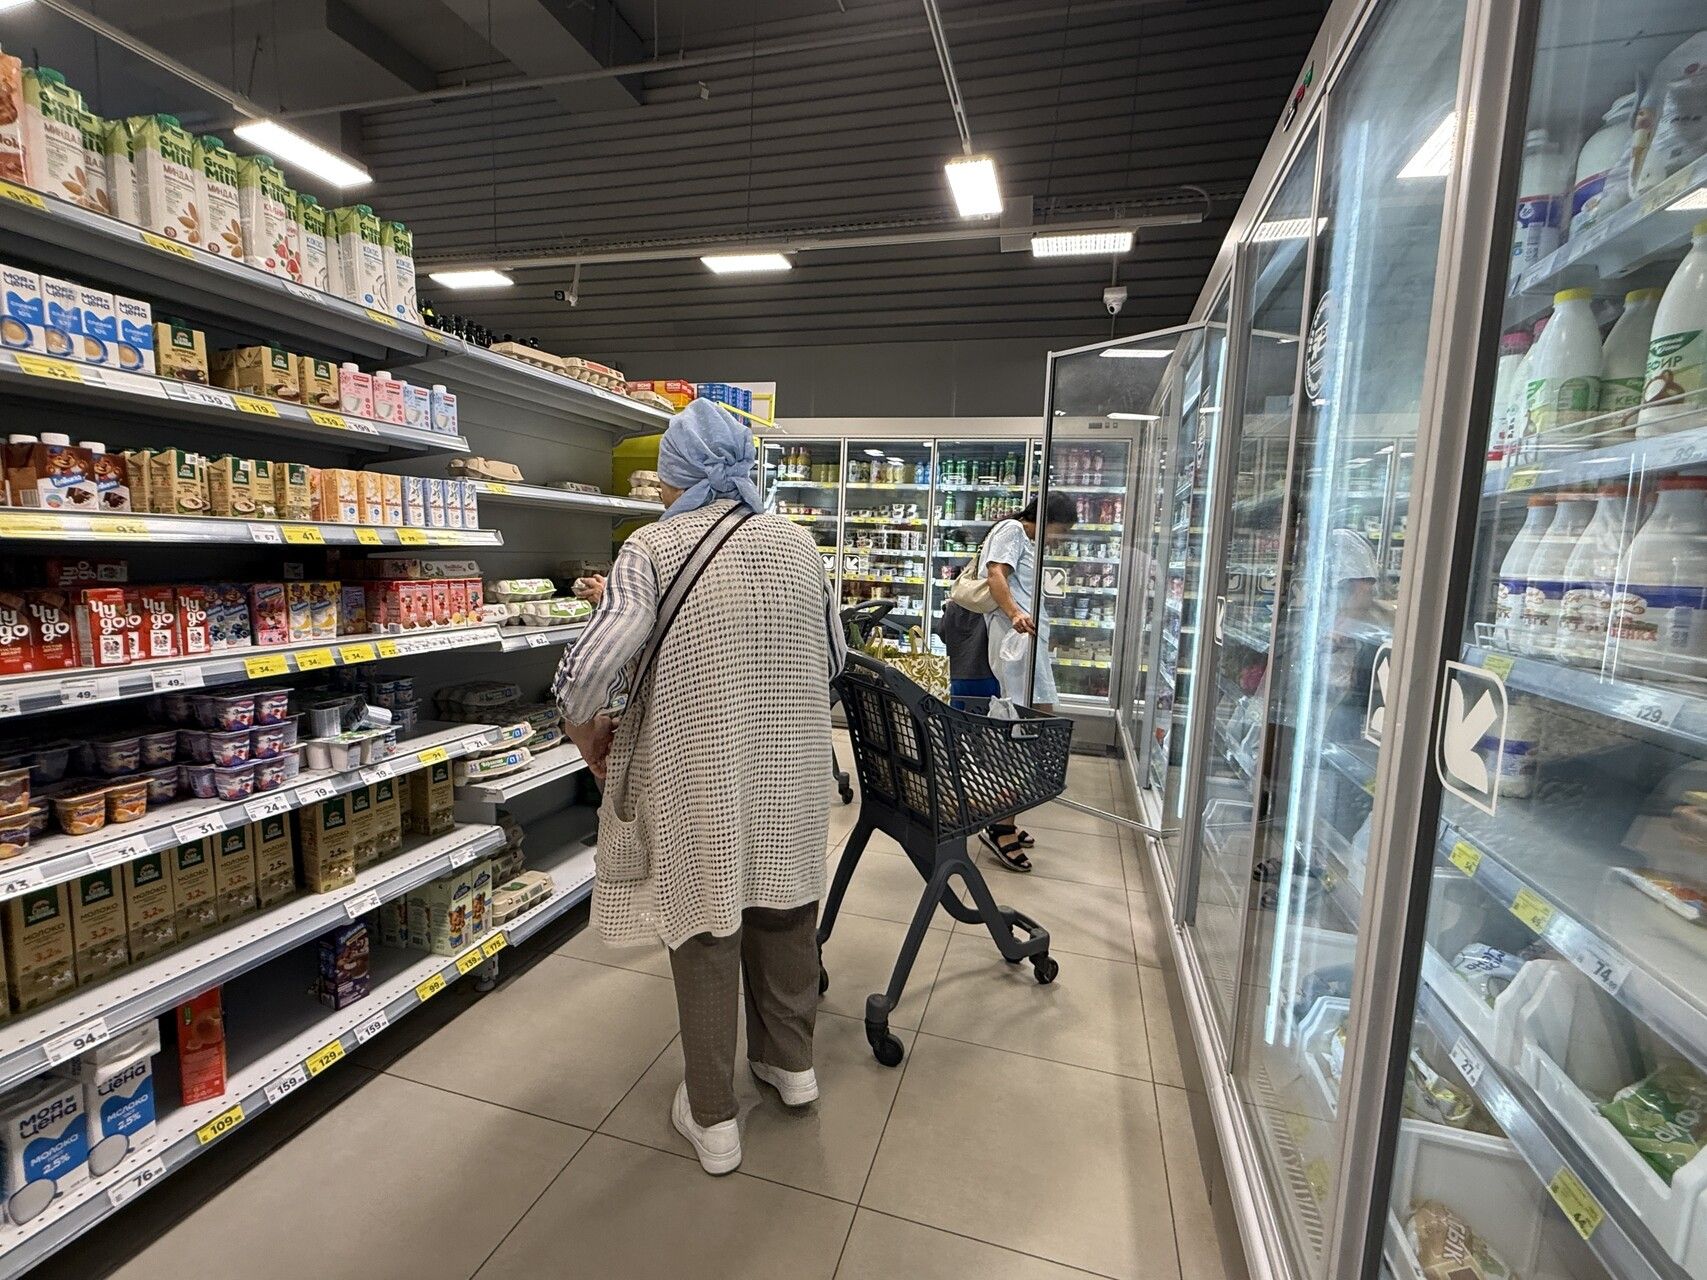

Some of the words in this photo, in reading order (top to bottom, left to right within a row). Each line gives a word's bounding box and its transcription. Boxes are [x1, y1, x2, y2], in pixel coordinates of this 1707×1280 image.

[203, 156, 237, 177] Green
[204, 166, 238, 190] Milk
[309, 658, 318, 666] 34
[168, 679, 180, 687] 49
[77, 691, 92, 699] 49
[1636, 706, 1662, 722] 129
[314, 788, 328, 798] 19
[264, 803, 280, 815] 24
[199, 822, 215, 834] 31
[220, 854, 250, 868] МОЛОКО
[177, 868, 209, 882] МОЛОКО
[132, 884, 167, 901] МОЛОКО
[80, 902, 119, 920] МОЛОКО
[22, 922, 65, 942] МОЛОКО
[464, 956, 477, 969] 139
[1592, 960, 1609, 983] 74
[429, 981, 440, 993] 99
[365, 1021, 381, 1036] 159
[73, 1032, 96, 1050] 94
[319, 1051, 337, 1067] 129
[1460, 1059, 1474, 1076] 27
[277, 1077, 297, 1094] 159
[19, 1097, 64, 1131] МОЯ
[106, 1093, 149, 1123] МОЛОКО
[210, 1115, 233, 1135] 109
[30, 1133, 79, 1167] МОЛОКО
[132, 1169, 153, 1187] 76
